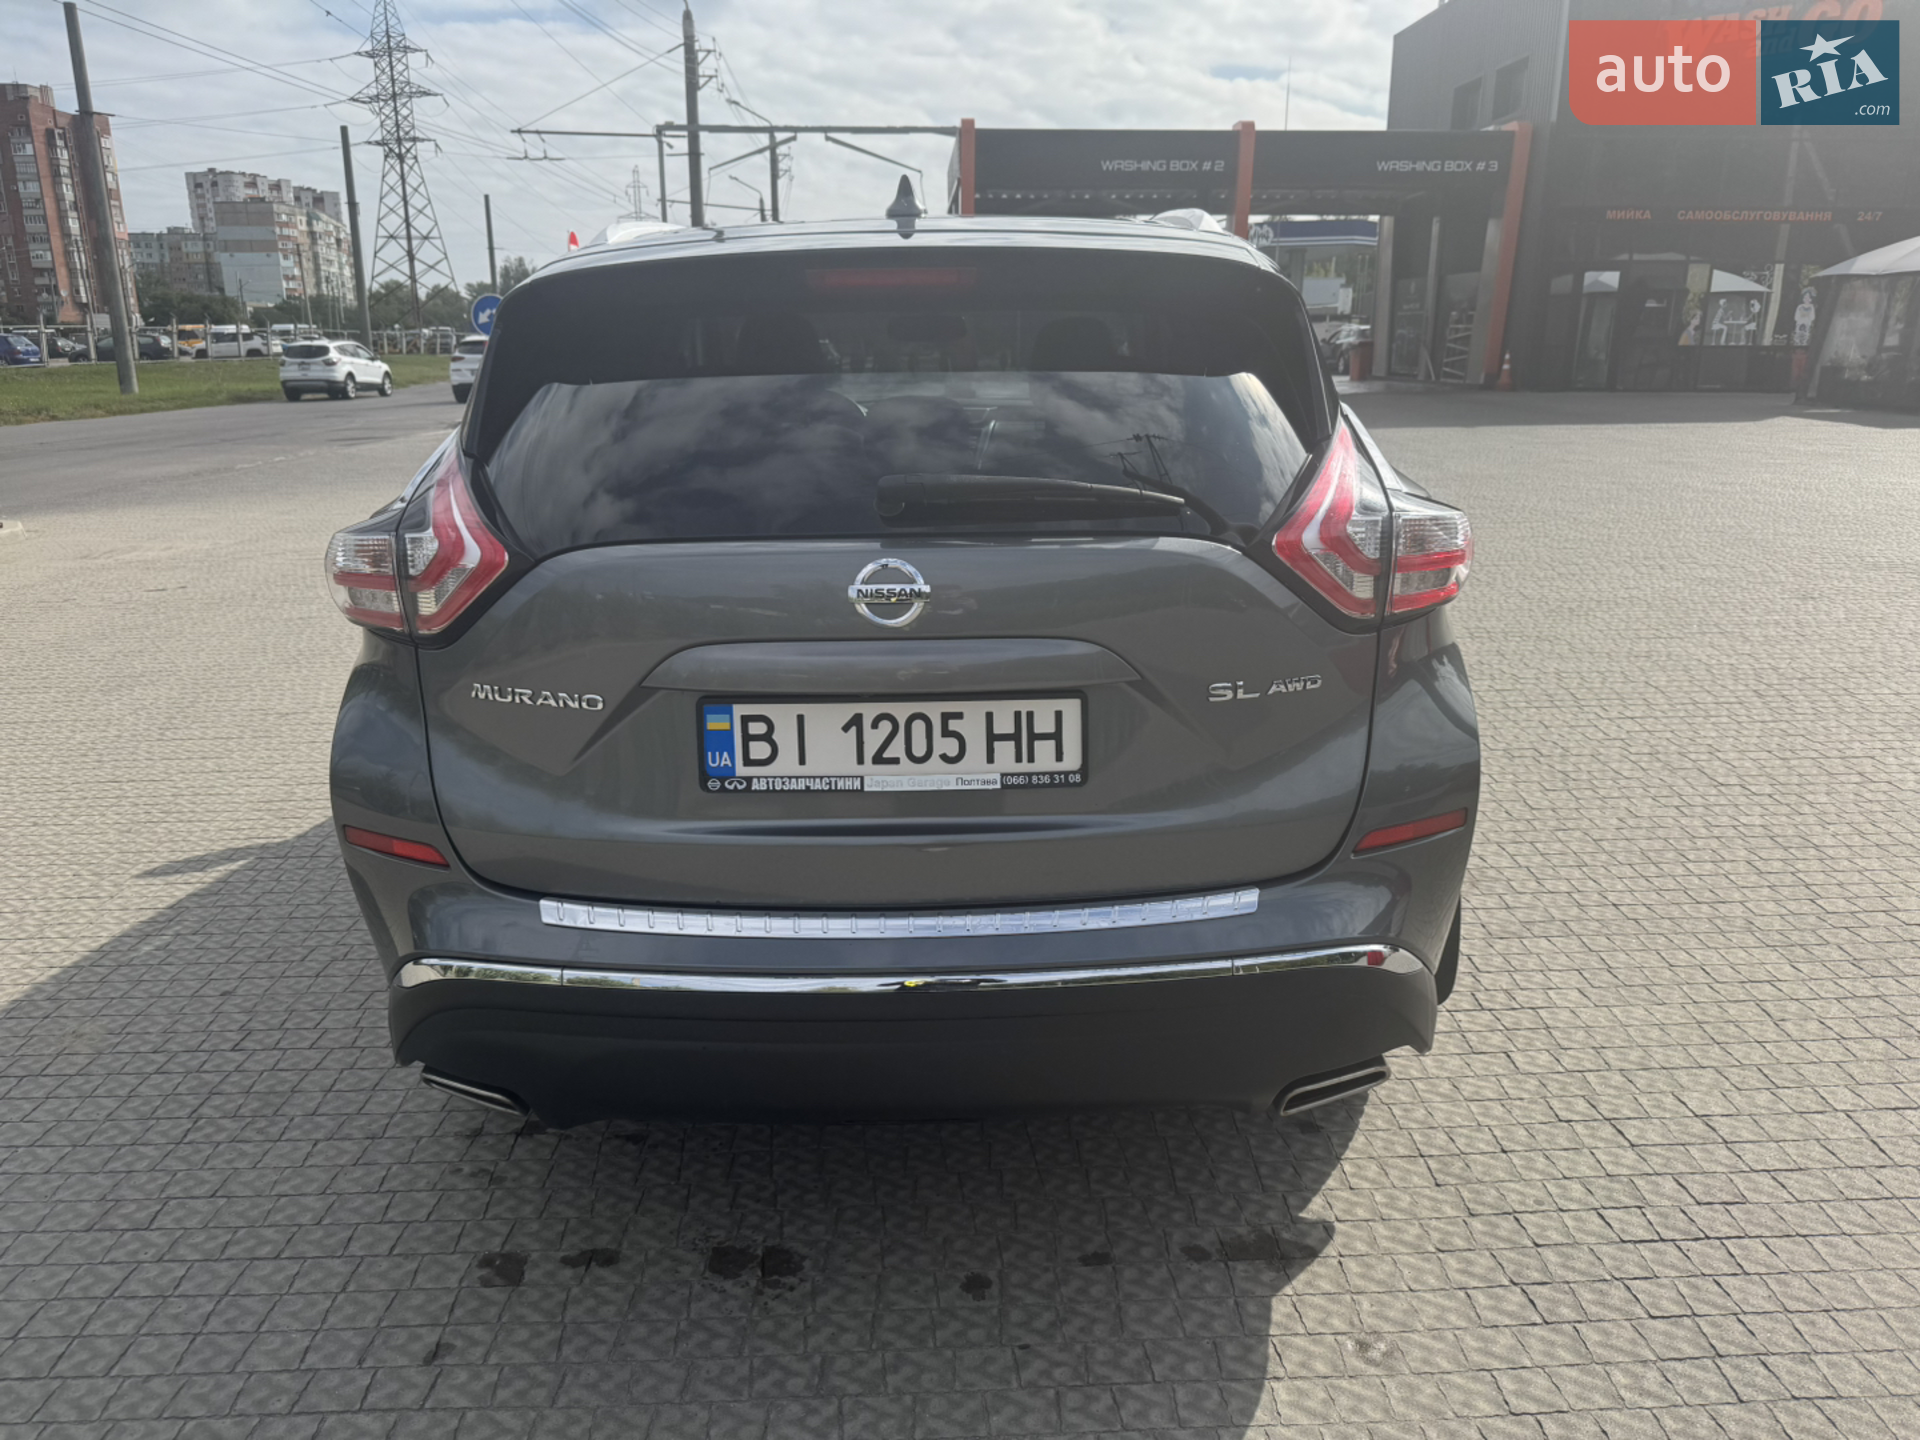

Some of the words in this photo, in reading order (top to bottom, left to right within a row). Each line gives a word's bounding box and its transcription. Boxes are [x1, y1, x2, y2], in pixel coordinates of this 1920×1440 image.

[1100, 159, 1167, 172] WASHING
[1169, 159, 1199, 172] BOX
[1376, 159, 1442, 172] WASHING
[1443, 159, 1473, 172] BOX
[1606, 208, 1652, 220] МИЙКА
[1677, 209, 1833, 221] САМООБСЛУГОВУВАННЯ
[1856, 211, 1883, 221] 24/7
[856, 587, 922, 599] NISSAN
[1208, 680, 1261, 702] SL
[1267, 674, 1322, 696] AWD
[471, 683, 604, 711] MURANO
[841, 711, 967, 766] 1205
[985, 710, 1064, 765] HH
[707, 751, 733, 768] UA
[751, 777, 861, 791] АВТОЗАПЧАСТИНИ
[866, 777, 904, 789] Japan
[907, 776, 951, 789] Garage
[956, 776, 998, 787] Полтава
[1002, 775, 1029, 785] (066)
[1031, 774, 1051, 784] 836
[1053, 774, 1066, 784] 31
[1068, 773, 1082, 783] 08
